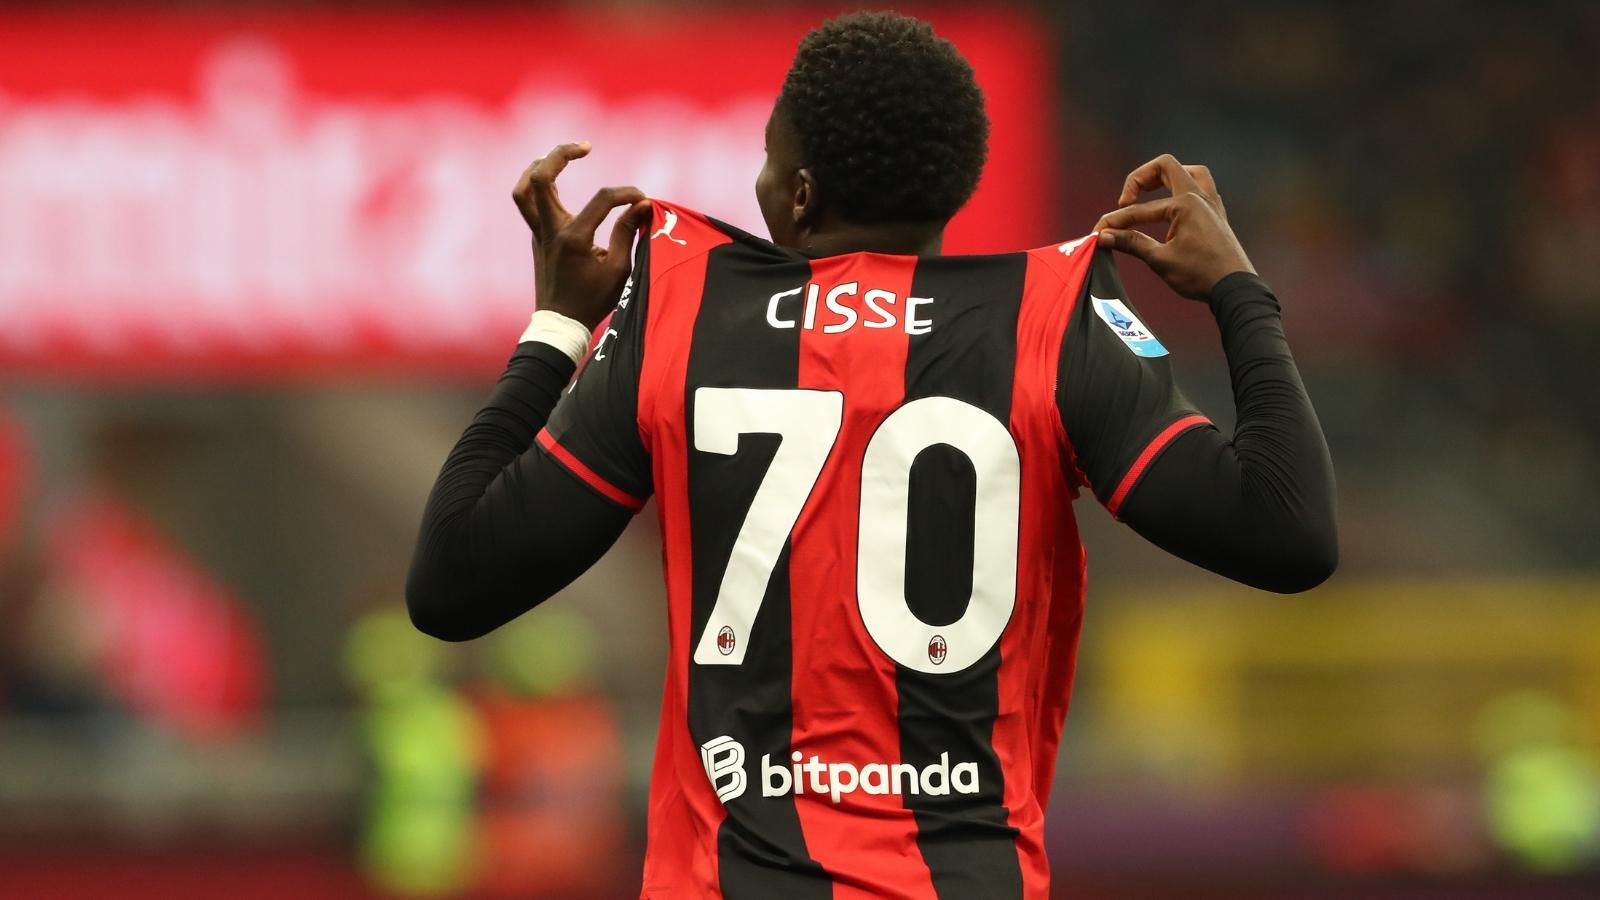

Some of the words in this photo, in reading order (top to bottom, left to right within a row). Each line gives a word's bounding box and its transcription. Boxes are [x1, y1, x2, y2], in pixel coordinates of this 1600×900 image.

[766, 281, 935, 336] CISSE
[693, 387, 1021, 675] 70
[761, 751, 980, 804] bitpanda
